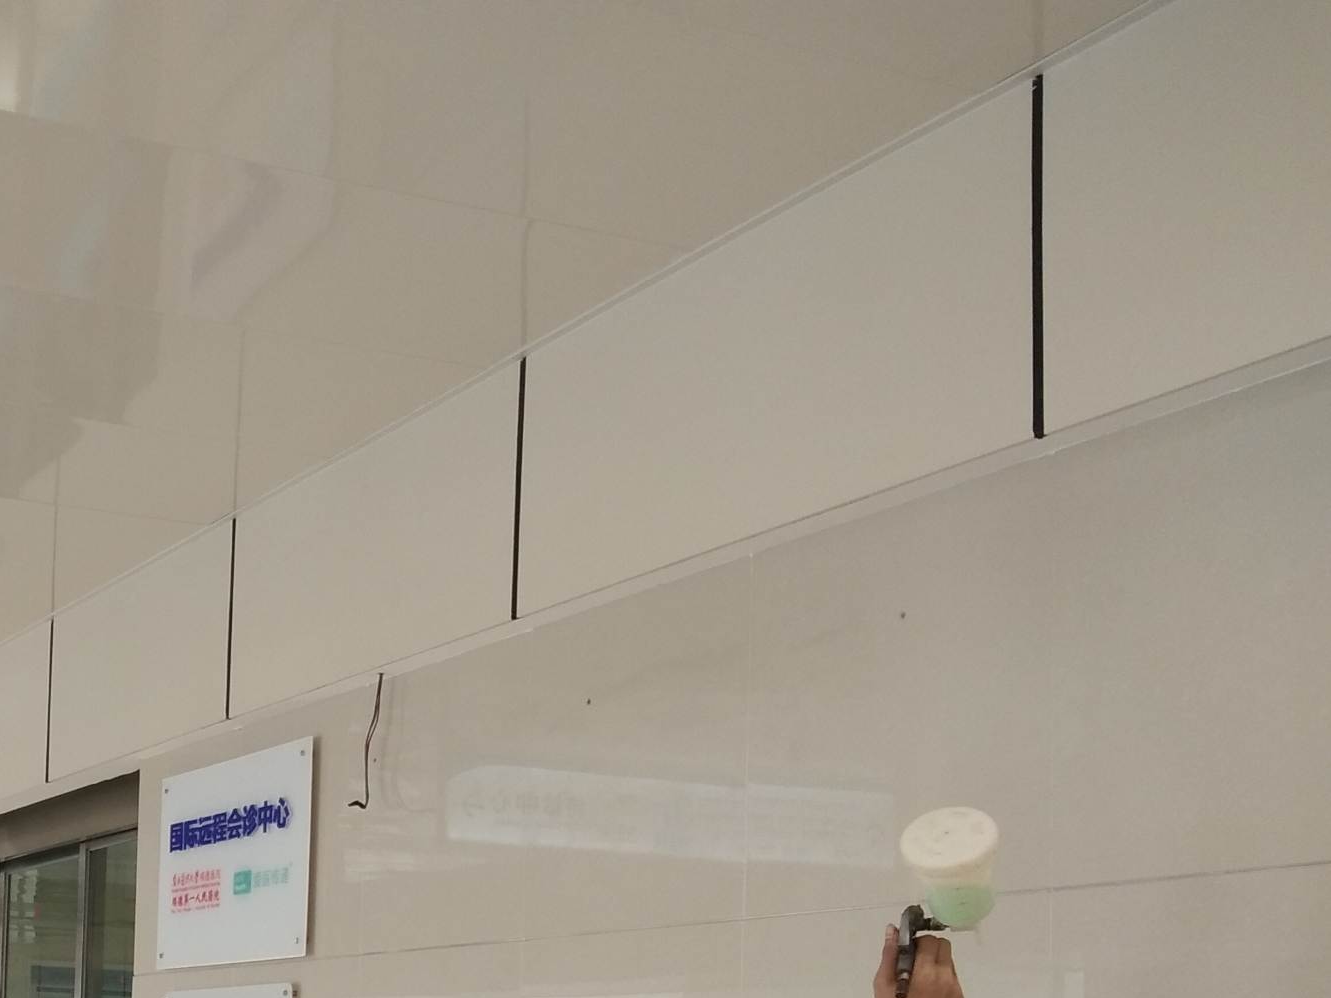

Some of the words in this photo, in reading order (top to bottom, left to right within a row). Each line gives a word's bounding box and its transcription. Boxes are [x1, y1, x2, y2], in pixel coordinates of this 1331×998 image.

[170, 797, 290, 853] 国际远程会诊中心
